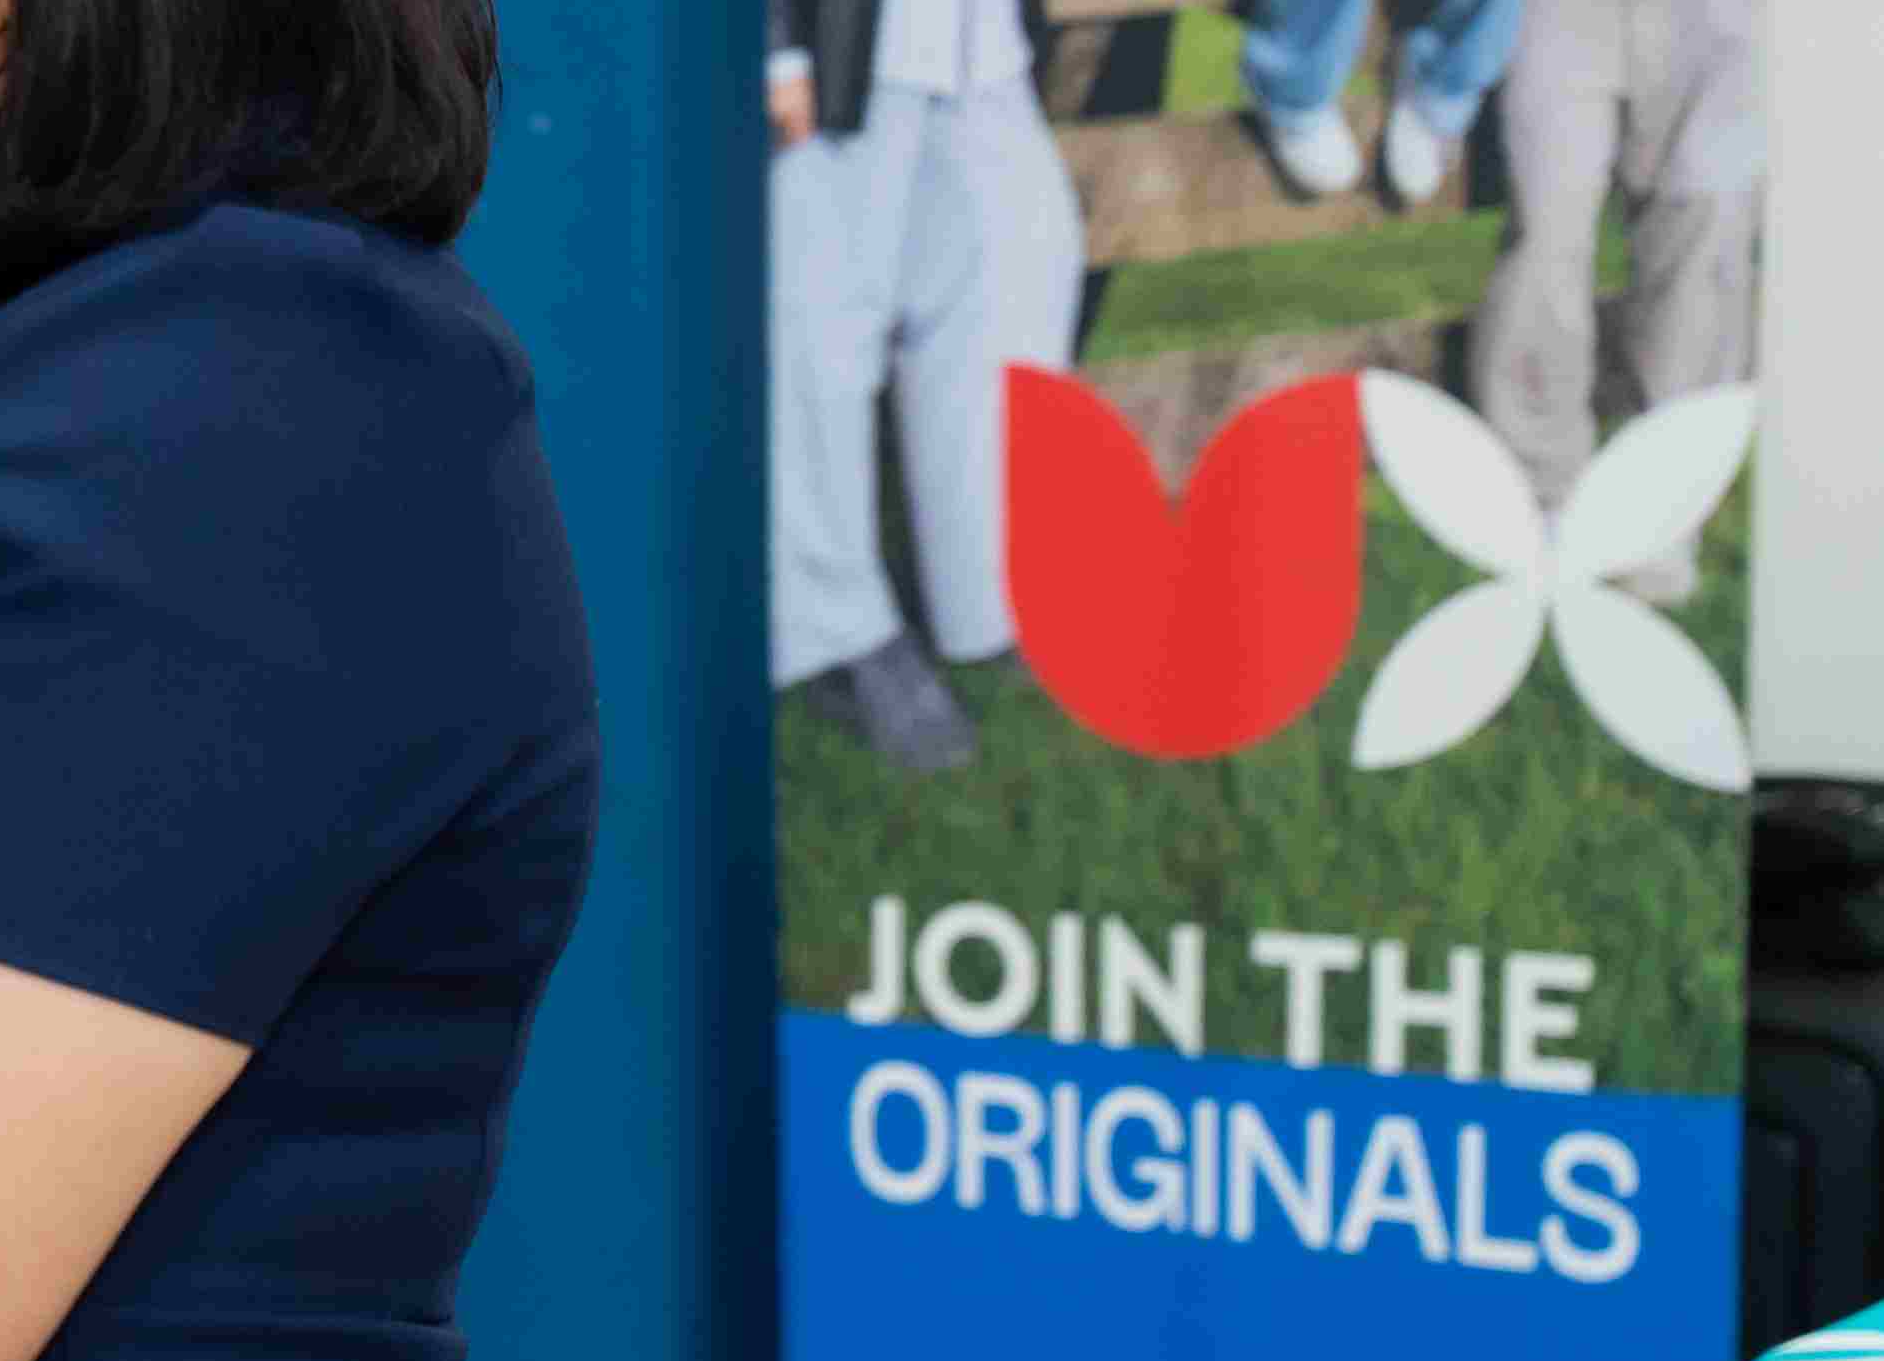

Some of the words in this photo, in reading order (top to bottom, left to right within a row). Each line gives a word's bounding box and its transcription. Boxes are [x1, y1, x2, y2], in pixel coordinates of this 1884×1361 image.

[845, 893, 1204, 1058] JOIN
[1251, 926, 1596, 1096] THE
[848, 1060, 1641, 1283] ORIGINALS
